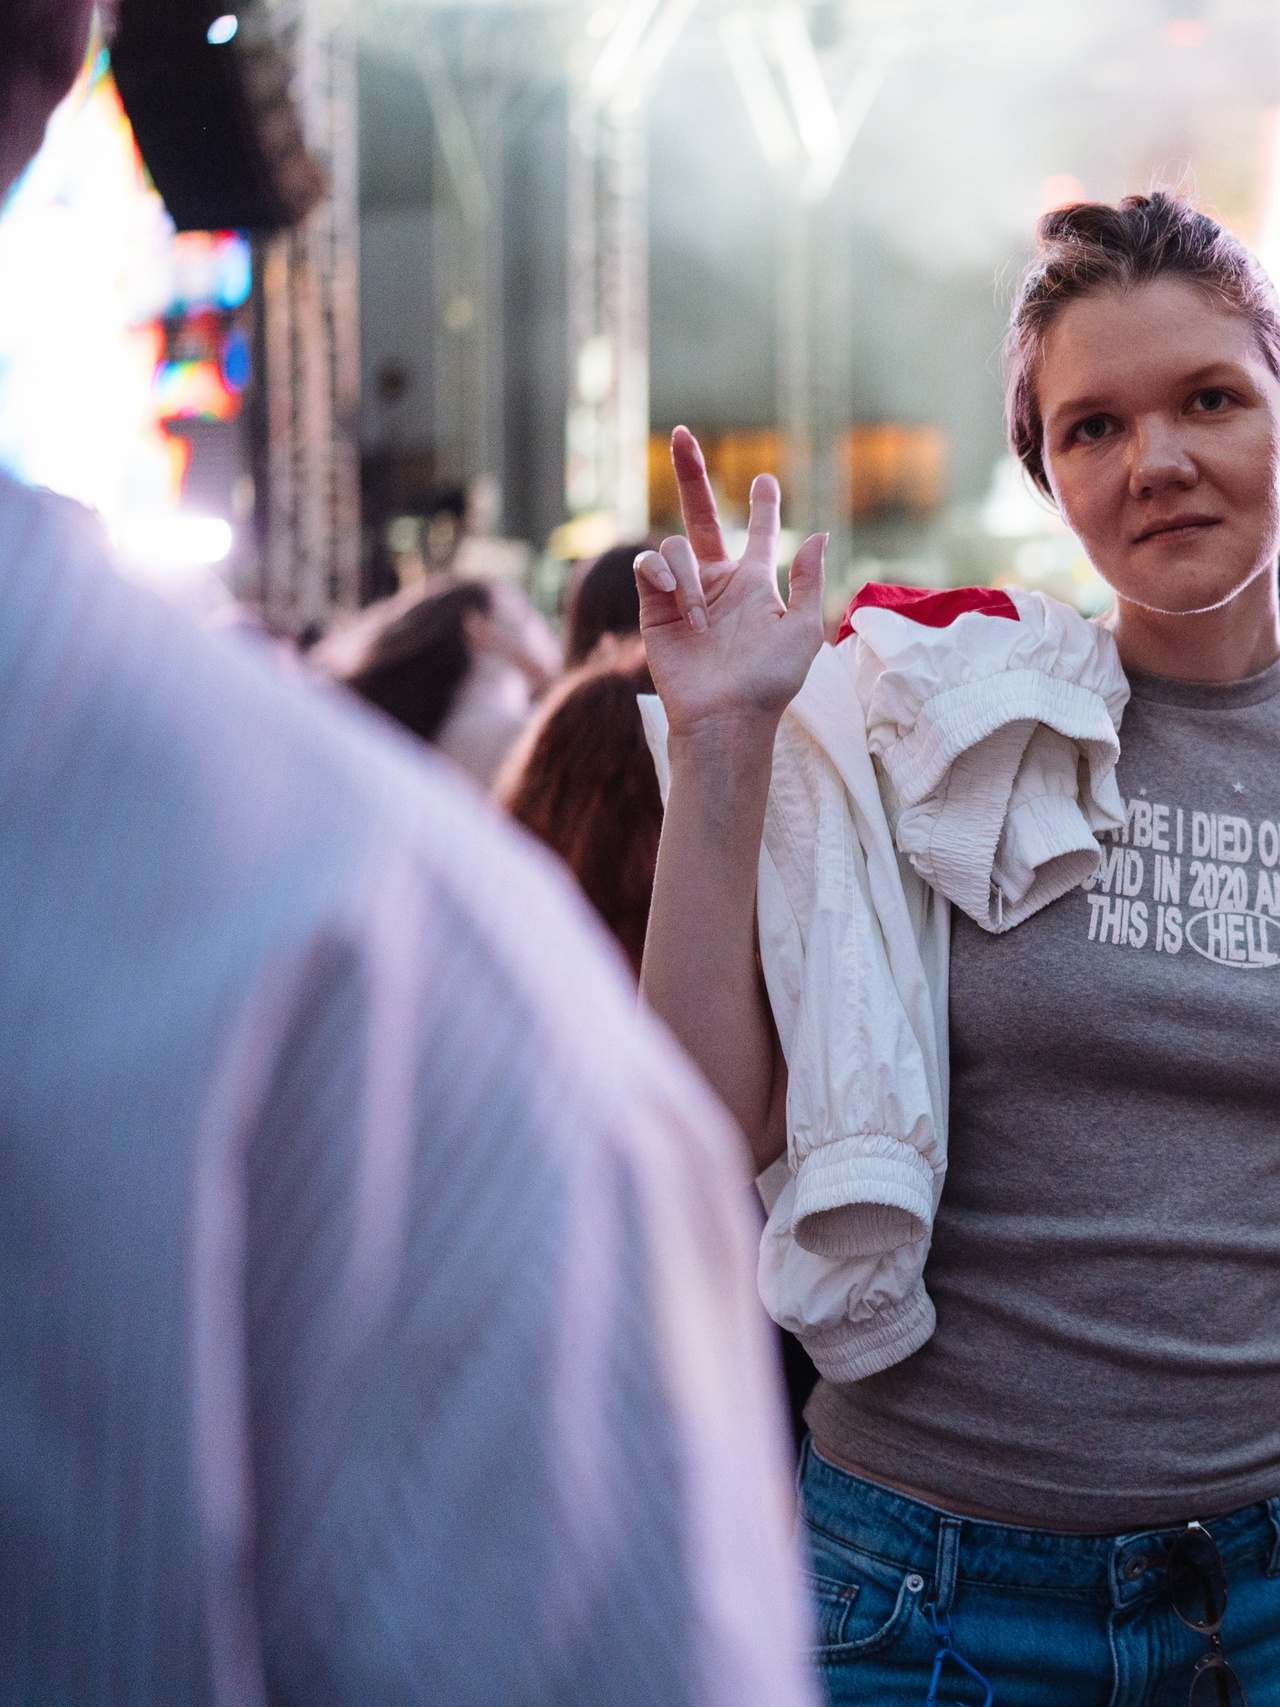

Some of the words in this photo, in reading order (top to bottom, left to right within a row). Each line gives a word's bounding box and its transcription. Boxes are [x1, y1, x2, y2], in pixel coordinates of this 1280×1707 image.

[1176, 808, 1184, 854] I
[1192, 811, 1252, 864] DIED
[1153, 854, 1182, 905] IN
[1188, 861, 1249, 912] 2020
[1087, 893, 1149, 949] THIS
[1155, 905, 1184, 954] IS
[1206, 913, 1279, 963] HELL
